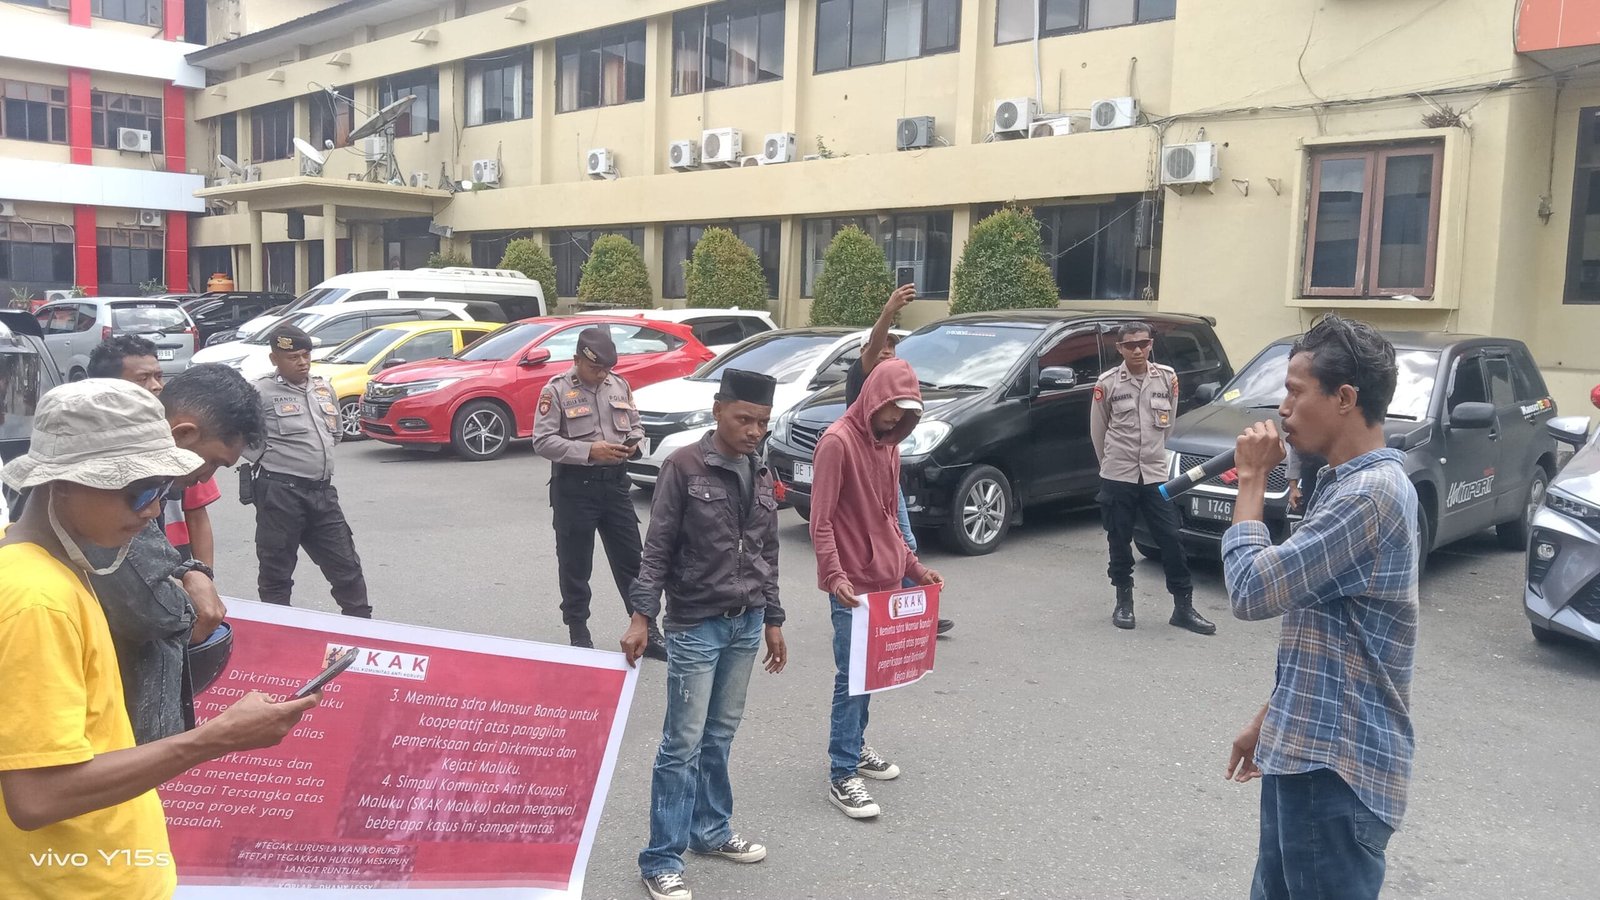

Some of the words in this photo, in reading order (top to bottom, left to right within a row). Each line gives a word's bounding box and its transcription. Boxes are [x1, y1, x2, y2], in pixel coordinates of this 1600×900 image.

[795, 464, 804, 476] DE
[1192, 497, 1199, 511] N
[1208, 499, 1232, 515] 1746
[228, 669, 301, 688] Dirkrimsus
[390, 688, 400, 702] 3.
[404, 690, 459, 708] Meminta
[460, 696, 487, 711] sdra
[489, 700, 532, 716] Mansur
[534, 704, 568, 719] Banda
[569, 708, 600, 722] untuk
[293, 728, 325, 740] alias
[418, 712, 484, 735] kooperatif
[484, 721, 510, 734] atas
[510, 724, 566, 740] panggilan
[392, 734, 470, 752] pemeriksaan
[472, 739, 498, 753] dari
[498, 741, 555, 758] Dirkrimsus
[556, 746, 578, 759] dan
[287, 757, 313, 770] dan
[442, 757, 477, 774] Kejati
[478, 760, 521, 775] Maluku.
[204, 770, 292, 786] menetapkan
[296, 774, 325, 788] sdra
[382, 774, 392, 788] 4.
[396, 775, 438, 791] Simpul
[438, 778, 500, 794] Komunitas
[502, 782, 527, 795] Anti
[527, 783, 568, 799] Korupsi
[158, 781, 218, 796] sebagai
[221, 786, 292, 804] Tersangka
[294, 792, 324, 804] atas
[208, 802, 256, 816] proyek
[259, 806, 294, 820] yang
[358, 794, 404, 810] Maluku
[406, 796, 444, 812] (SKAK
[444, 799, 492, 815] Maluku)
[492, 802, 521, 814] akan
[522, 804, 577, 818] mengawal
[365, 816, 424, 834] beberapa
[426, 818, 460, 832] kasus
[460, 820, 478, 832] ini
[478, 822, 518, 836] sampai
[519, 822, 555, 834] tuntas.
[254, 841, 293, 851] #TEGAK
[294, 844, 324, 852] LURUS
[326, 845, 360, 854] LAWAN
[362, 845, 401, 855] KORUPSI
[238, 852, 274, 861] #TETAP
[276, 854, 326, 864] TEGAKKAN
[328, 856, 363, 865] HUKUM
[364, 857, 410, 866] MESKIPUN
[284, 865, 320, 874] LANGIT
[320, 866, 360, 875] RUNTUH.
